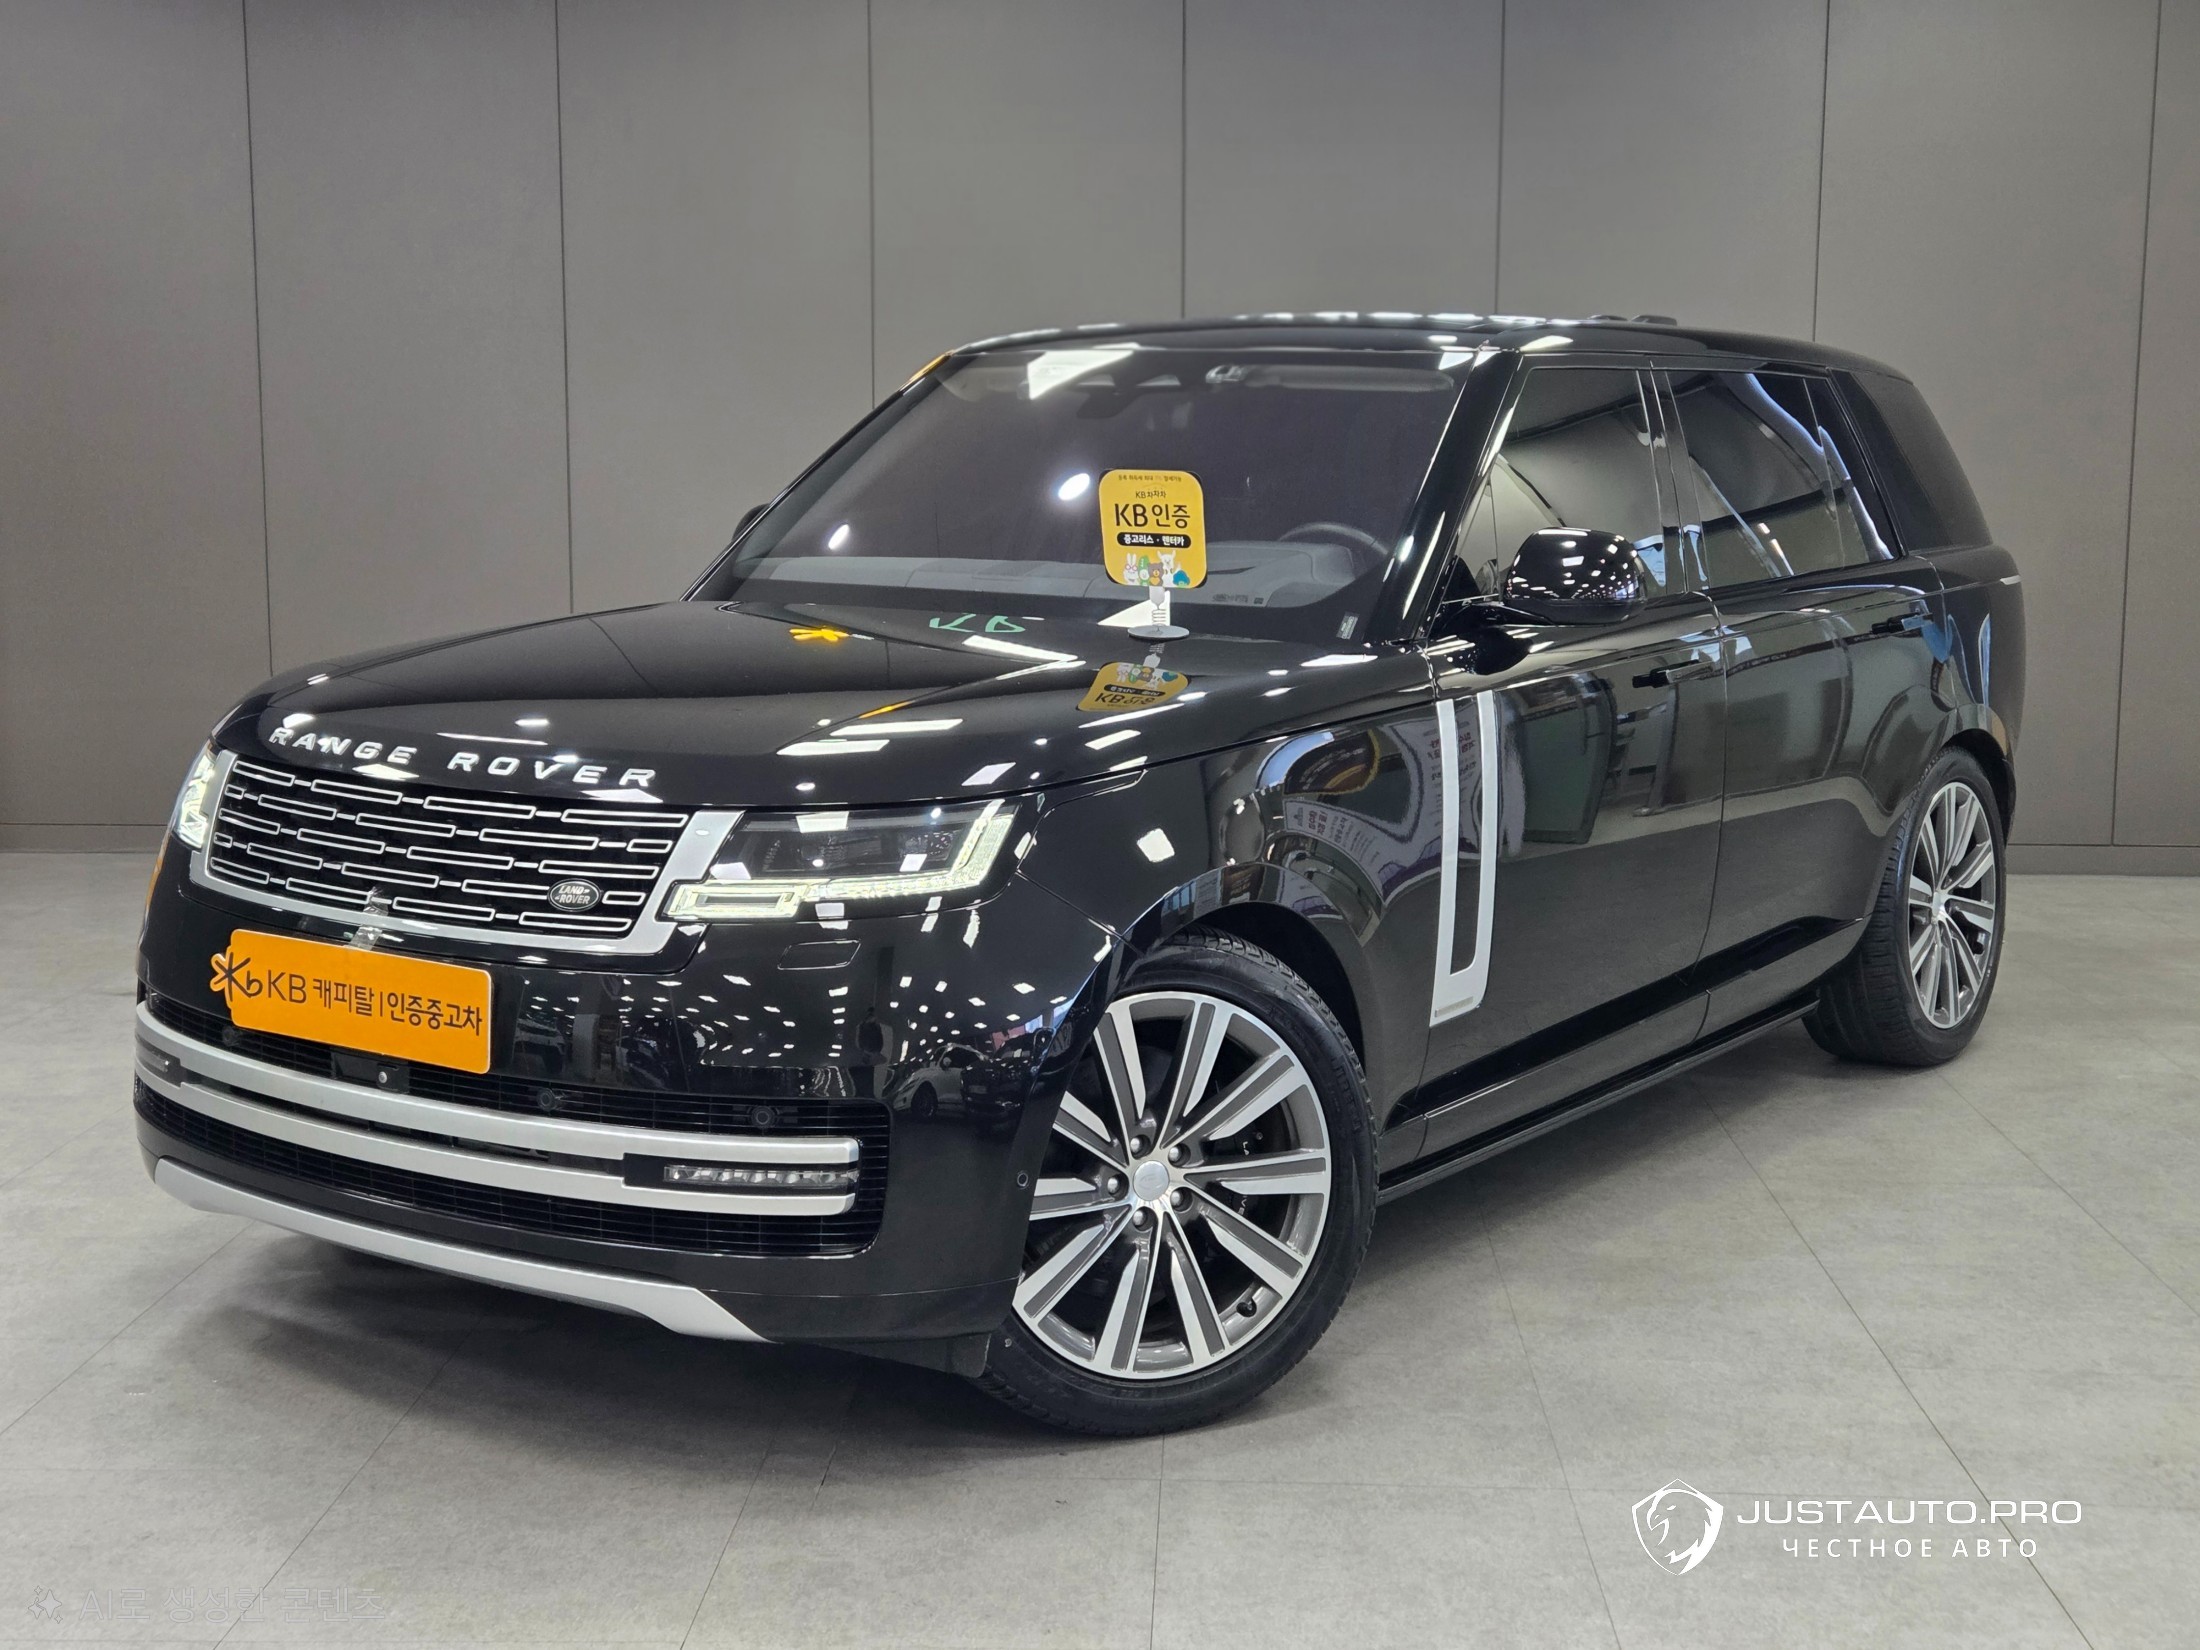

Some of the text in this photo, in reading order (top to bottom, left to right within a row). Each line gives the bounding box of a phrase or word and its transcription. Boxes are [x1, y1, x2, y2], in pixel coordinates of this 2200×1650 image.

[268, 726, 657, 788] RANGE ROVER
[559, 886, 584, 894] LAND
[559, 895, 590, 904] ROVER
[387, 992, 483, 1037] 인증중고차
